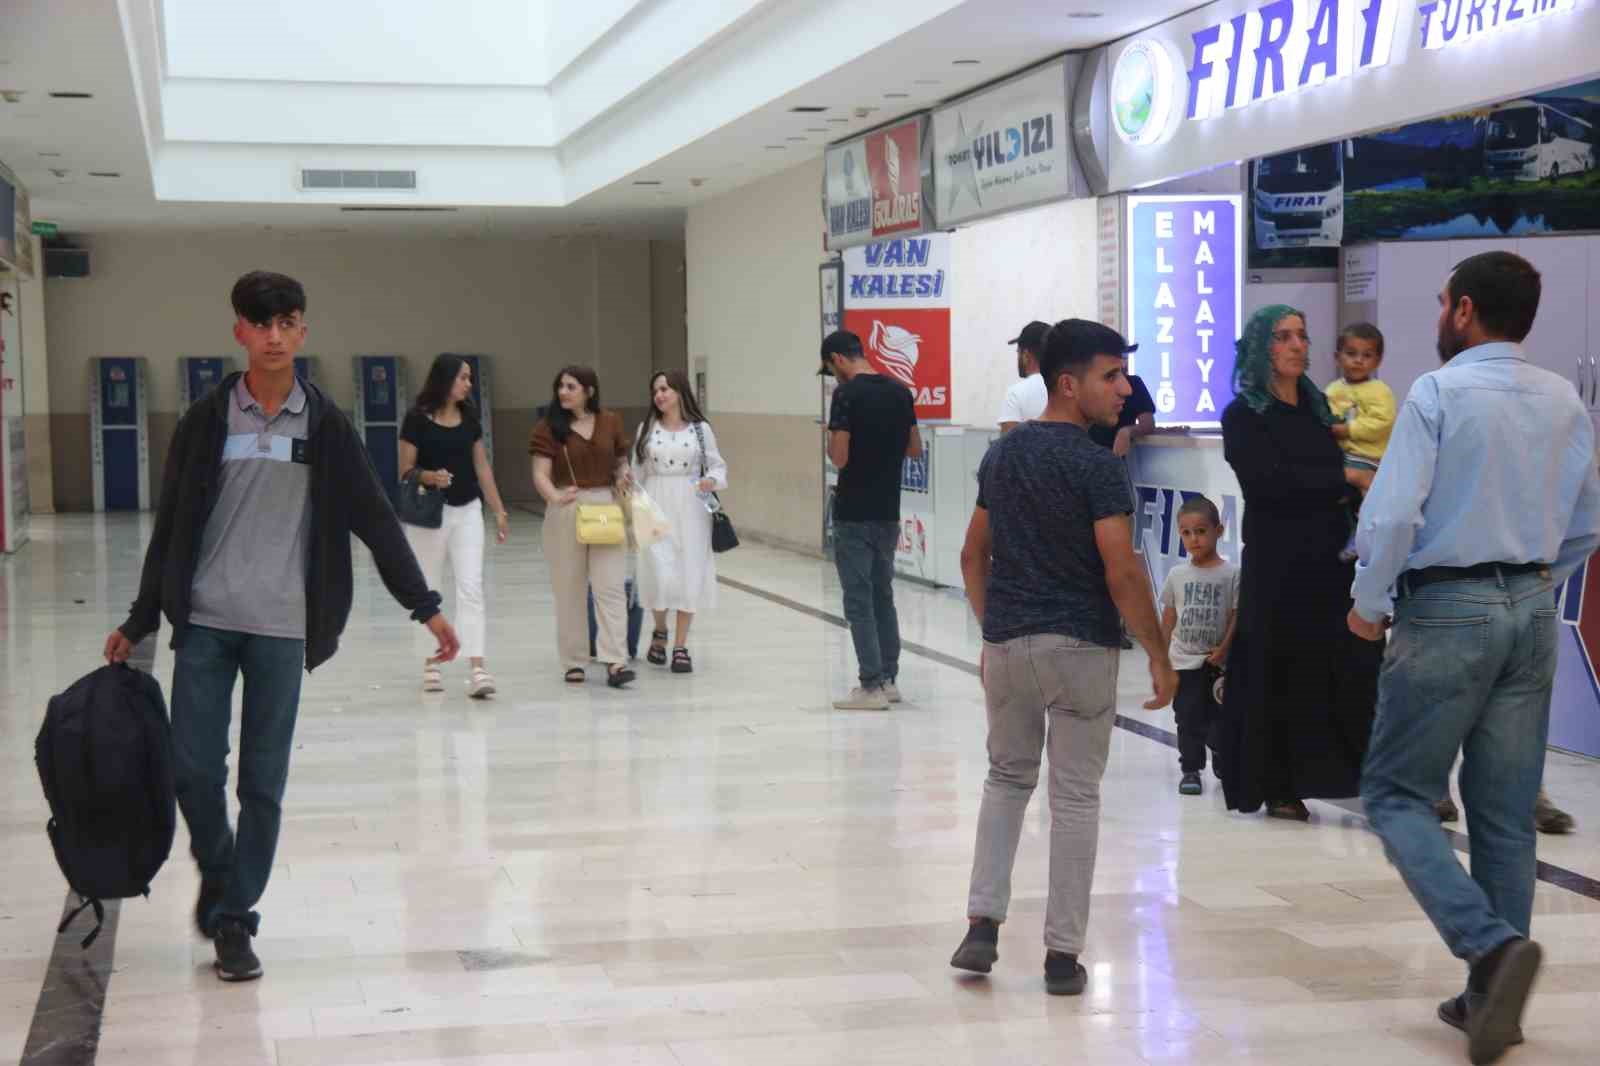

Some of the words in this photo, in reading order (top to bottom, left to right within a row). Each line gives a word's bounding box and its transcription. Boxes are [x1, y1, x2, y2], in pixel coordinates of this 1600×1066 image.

[1419, 0, 1556, 48] TUR
[973, 113, 1053, 171] YILDIZI
[1274, 195, 1326, 208] FIRAT
[864, 239, 931, 267] VAN
[850, 270, 944, 297] KALESİ
[1154, 211, 1176, 412] ELAZIĞ
[1193, 210, 1216, 413] MALATYA
